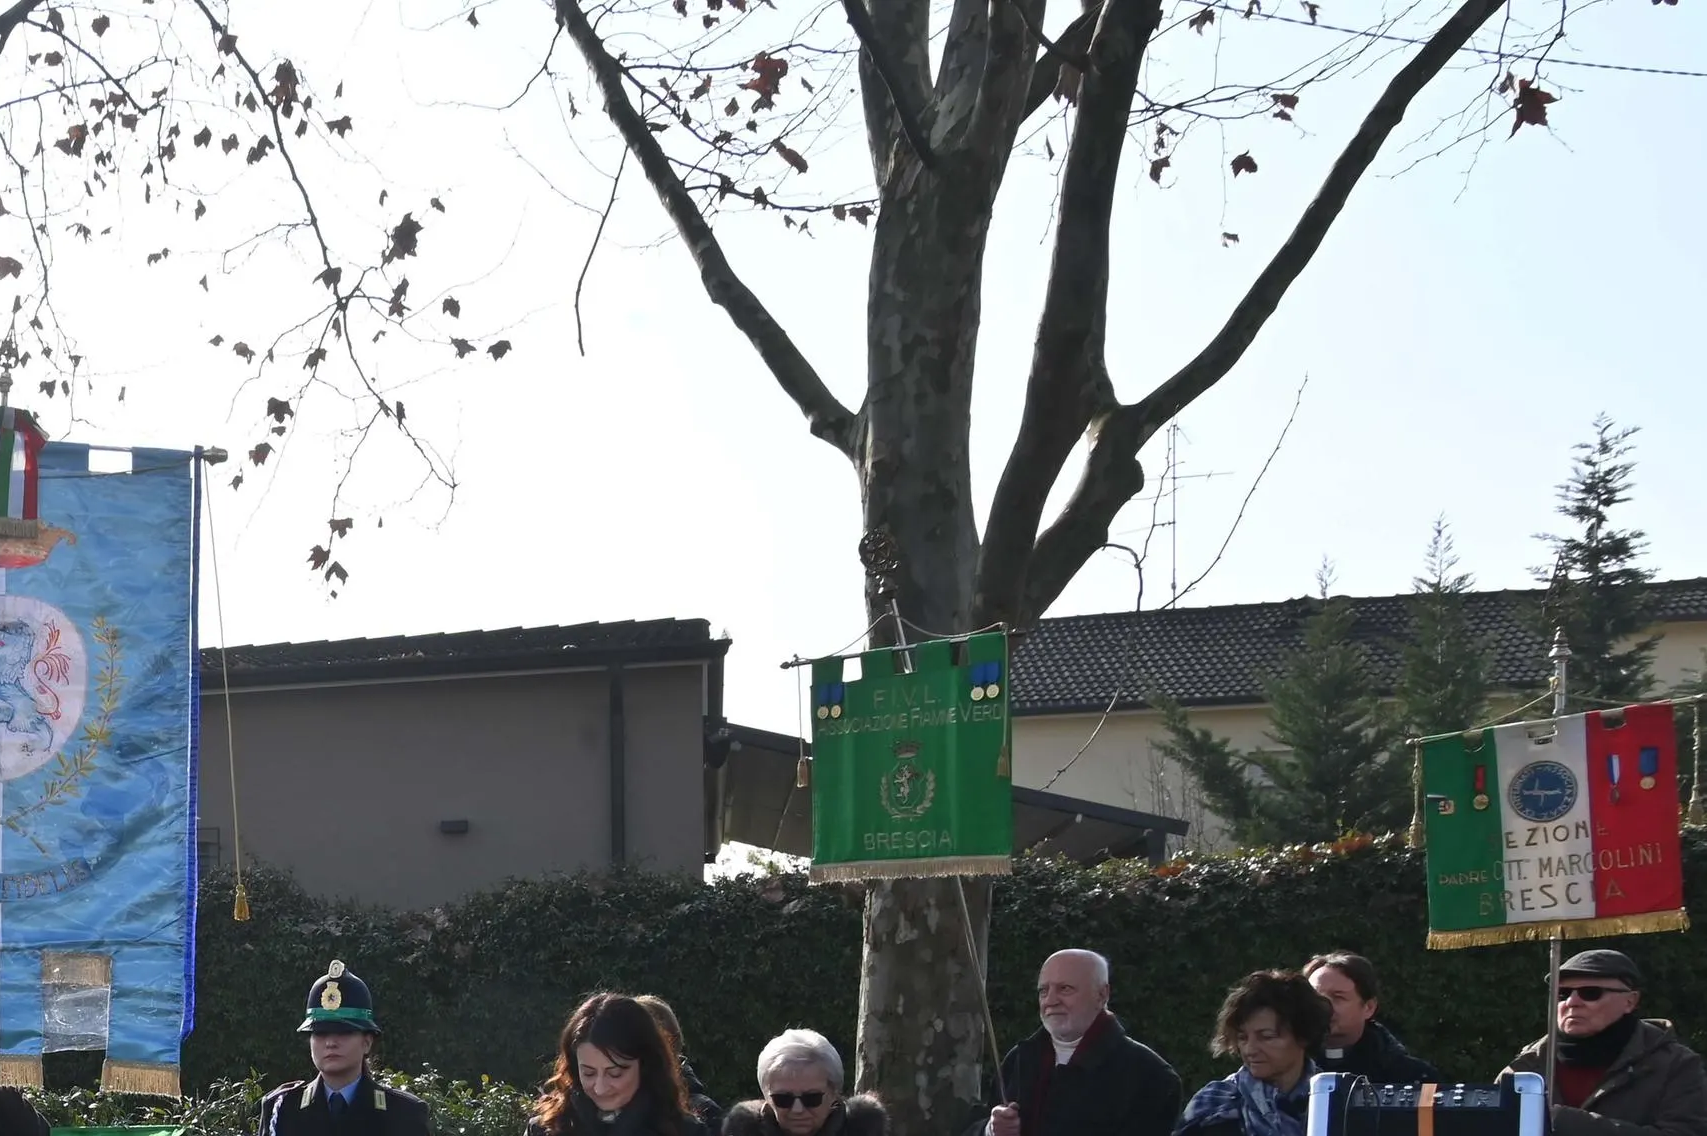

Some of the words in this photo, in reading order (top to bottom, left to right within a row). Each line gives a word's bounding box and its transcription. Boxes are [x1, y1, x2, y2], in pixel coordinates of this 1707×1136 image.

[864, 830, 953, 850] BRESCIA
[0, 861, 87, 899] FIDELIS
[1438, 869, 1488, 886] PADRE
[1538, 842, 1664, 878] MARCOLINI
[1479, 878, 1626, 916] BRESCIA
